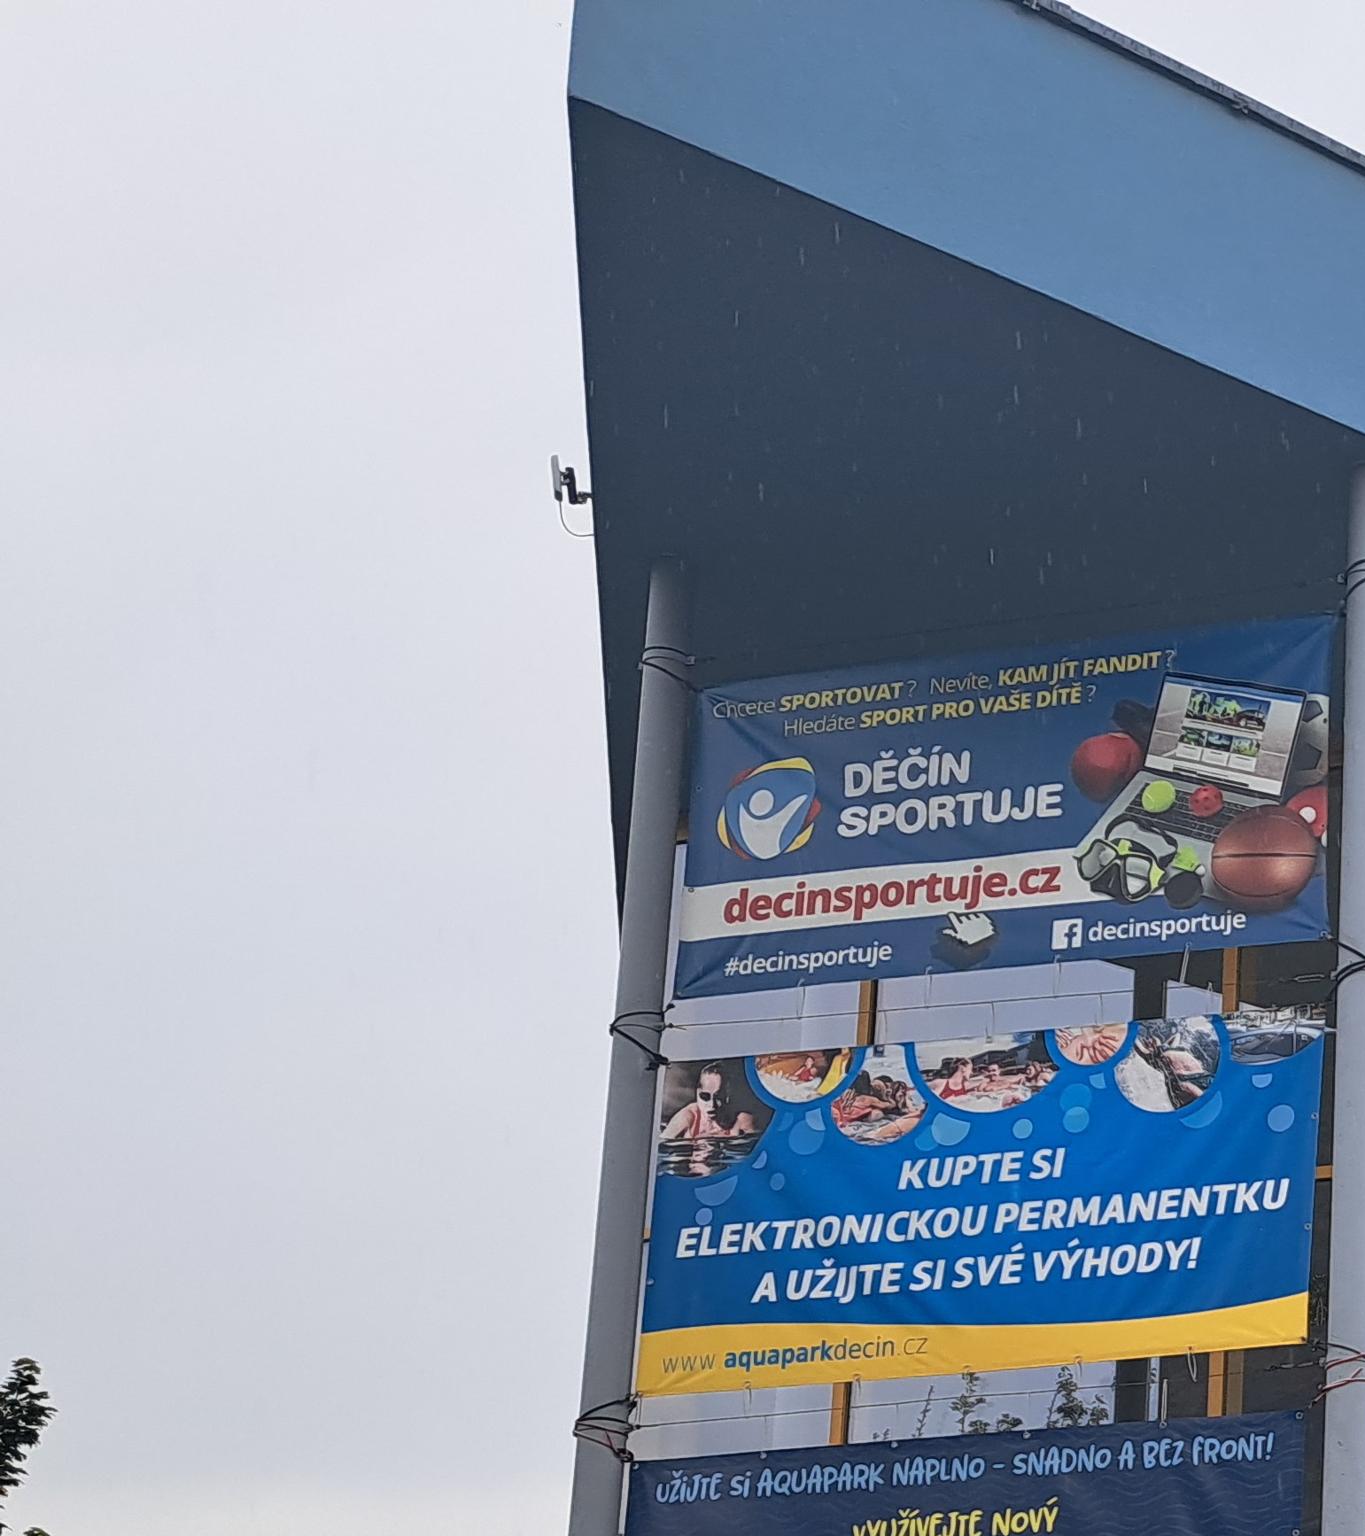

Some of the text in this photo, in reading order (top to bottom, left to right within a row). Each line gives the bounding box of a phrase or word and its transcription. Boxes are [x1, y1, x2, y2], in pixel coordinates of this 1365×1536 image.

[713, 701, 775, 717] Chcete
[931, 676, 992, 693] Nevíte,
[999, 665, 1047, 692] KAM
[1049, 658, 1080, 687] JÍT
[785, 714, 855, 735] Hledáte
[860, 705, 927, 727] SPORT
[932, 700, 974, 719] PRO
[980, 690, 1031, 713] VAŠE
[845, 746, 971, 798] DĚČÍN
[837, 784, 1064, 837] SPORTUJE
[723, 865, 1062, 922] decinsportuje.cz
[1089, 910, 1246, 941] decinsportuje
[725, 942, 892, 976] #decinsportuje
[899, 1148, 1064, 1189] KUPTE SI
[677, 1179, 1289, 1257] ELEKTRONICKOU PERMANENTKU
[752, 1238, 1200, 1303] A UŽIJTE SI SVÉ VÝHODY!
[758, 1463, 883, 1496] AQUAPARK
[893, 1455, 984, 1485] NAPLNO
[1014, 1445, 1111, 1475] SNADNO
[1119, 1442, 1135, 1469] A
[1144, 1439, 1183, 1468] BEZ
